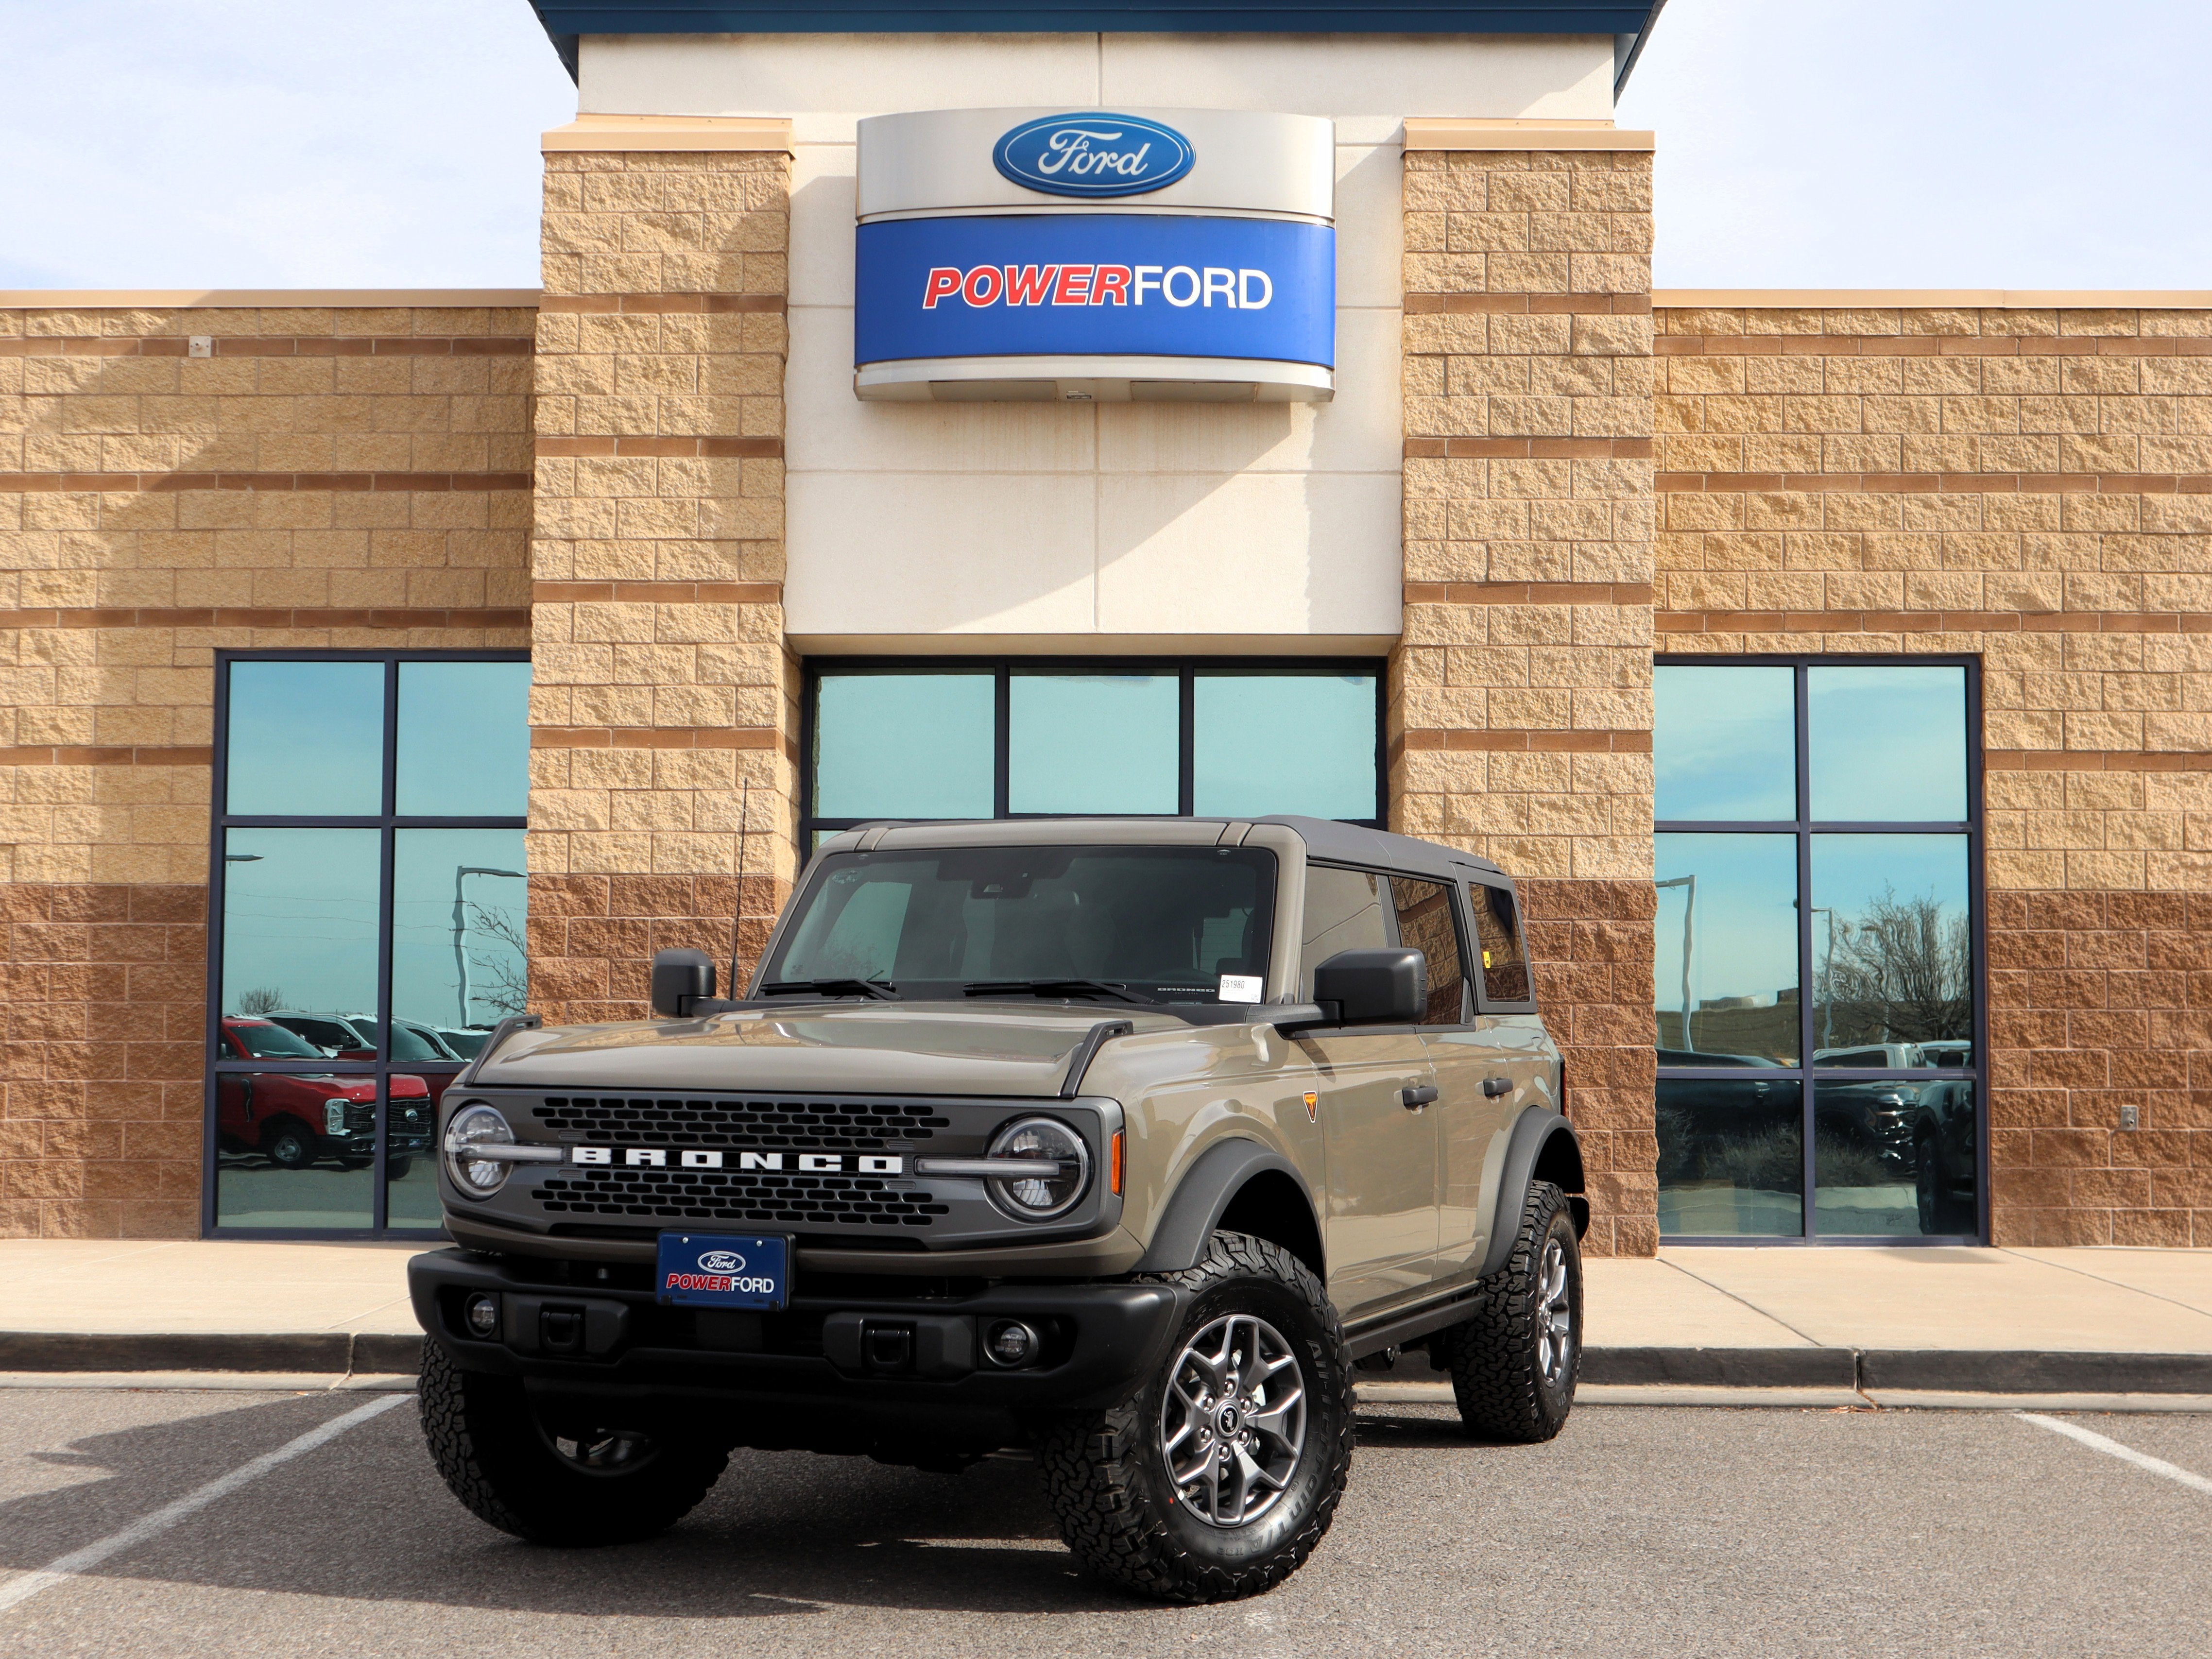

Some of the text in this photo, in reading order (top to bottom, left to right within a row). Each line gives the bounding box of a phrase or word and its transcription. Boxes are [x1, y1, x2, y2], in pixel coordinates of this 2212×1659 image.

[1038, 129, 1151, 176] Ford
[922, 264, 1273, 310] POWERFORD
[1221, 979, 1245, 989] 251980
[572, 1146, 903, 1174] BRONCO
[707, 1255, 736, 1269] Ford
[666, 1273, 774, 1293] POWERFORD
